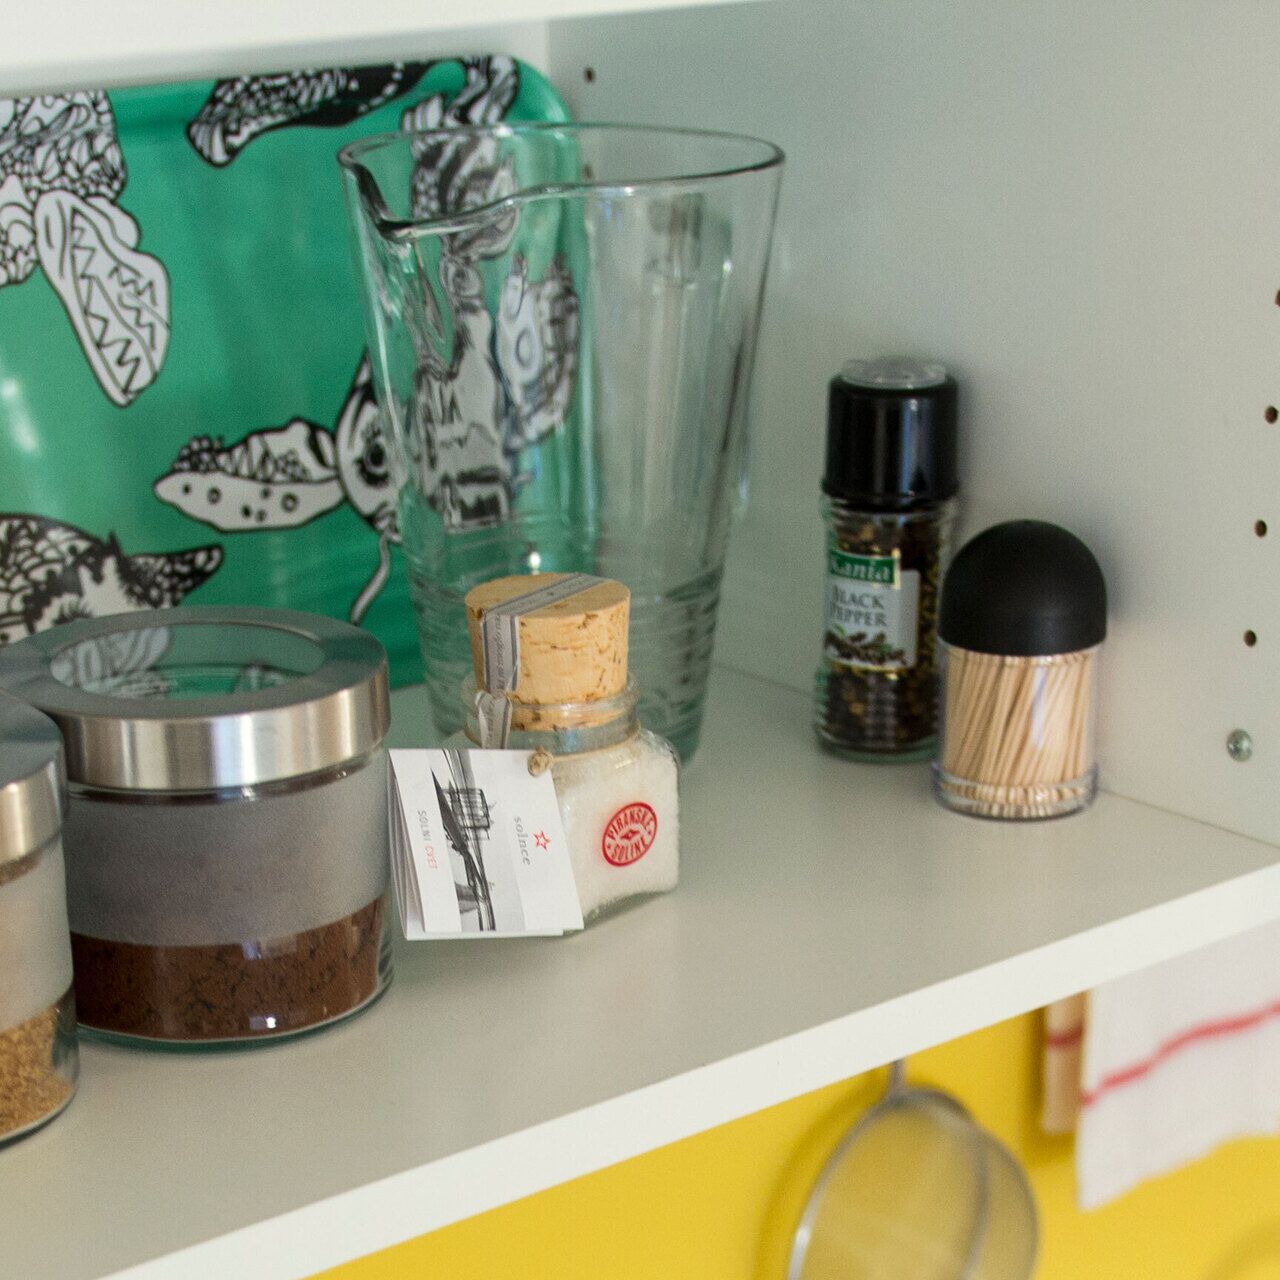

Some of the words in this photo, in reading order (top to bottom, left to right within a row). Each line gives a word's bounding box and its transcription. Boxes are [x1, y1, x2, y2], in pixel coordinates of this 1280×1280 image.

[831, 585, 885, 610] BLACK
[828, 604, 888, 627] PEPPER
[514, 817, 531, 866] solnce
